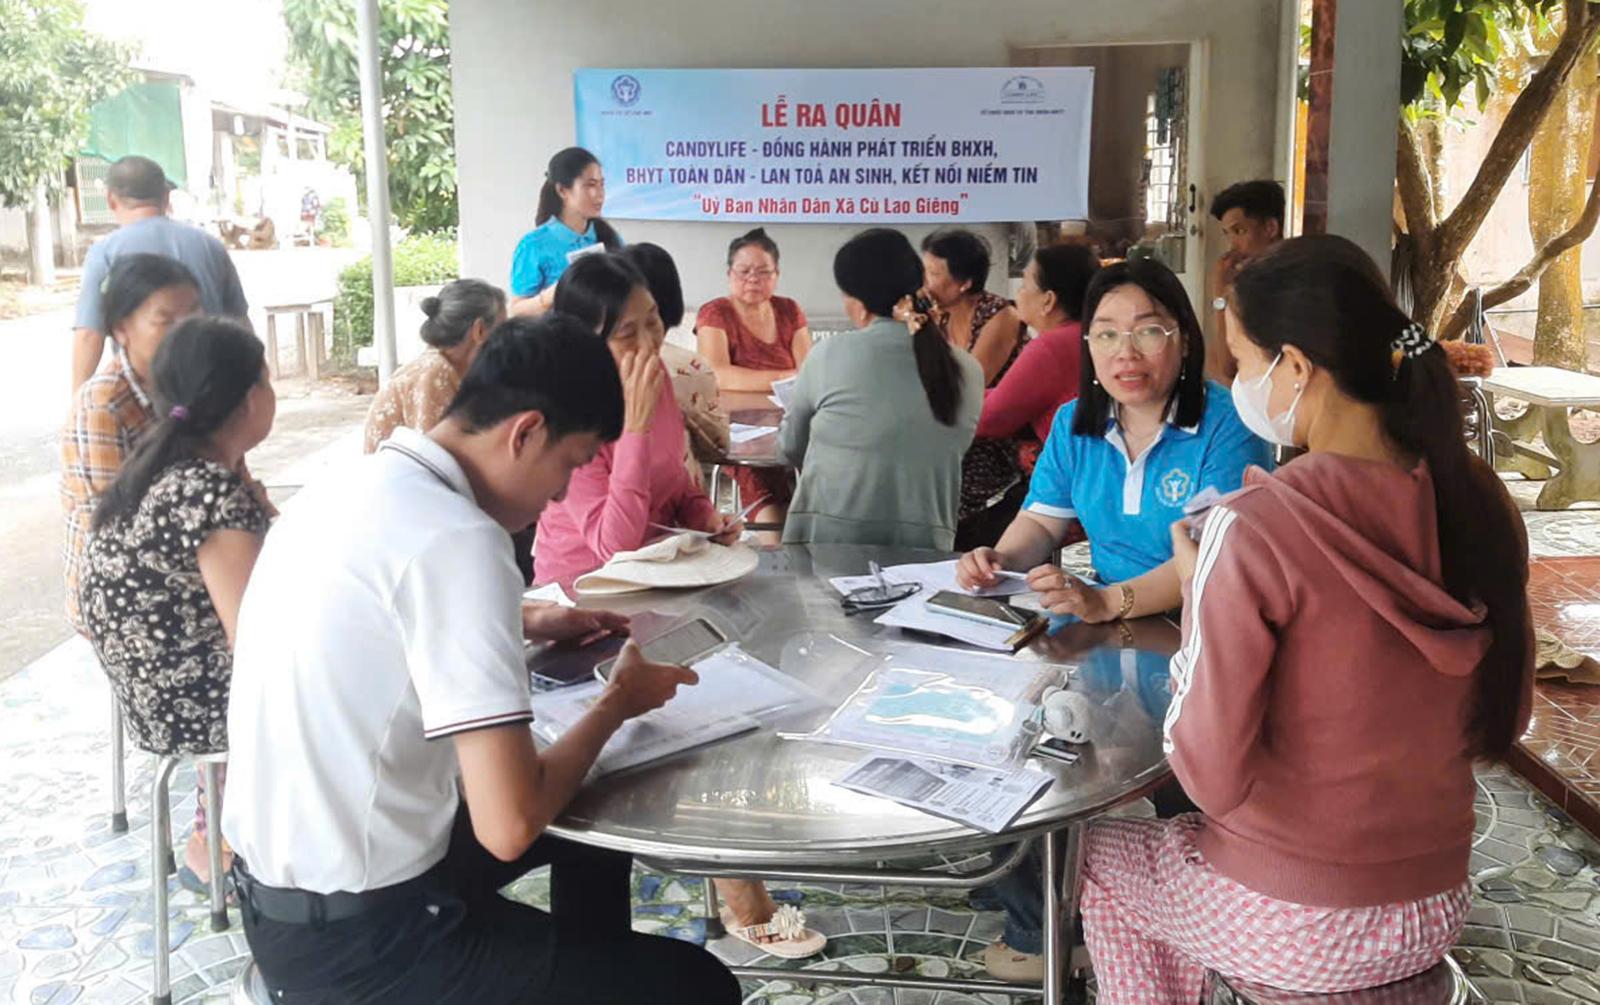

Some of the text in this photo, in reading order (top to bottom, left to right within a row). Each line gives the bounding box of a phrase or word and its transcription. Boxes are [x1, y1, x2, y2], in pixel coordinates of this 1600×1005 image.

[762, 95, 901, 130] LỄ RA QUÂN
[666, 141, 746, 157] CANDYLIFE
[857, 138, 896, 157] PHÁT
[951, 140, 998, 158] BHXH,
[626, 168, 663, 184] BHYT
[669, 165, 708, 184] TOÀN
[714, 165, 745, 184] DÂN
[761, 168, 790, 184] LAN
[829, 168, 850, 184] AN
[855, 168, 897, 186] SINH,
[902, 163, 930, 184] KẾT
[935, 162, 962, 184] NỐI
[1013, 167, 1038, 184] TIN
[725, 198, 753, 213] Ban
[758, 197, 797, 214] Nhân
[802, 198, 830, 214] Dân
[836, 197, 855, 214] Xã
[884, 198, 911, 214] Lao
